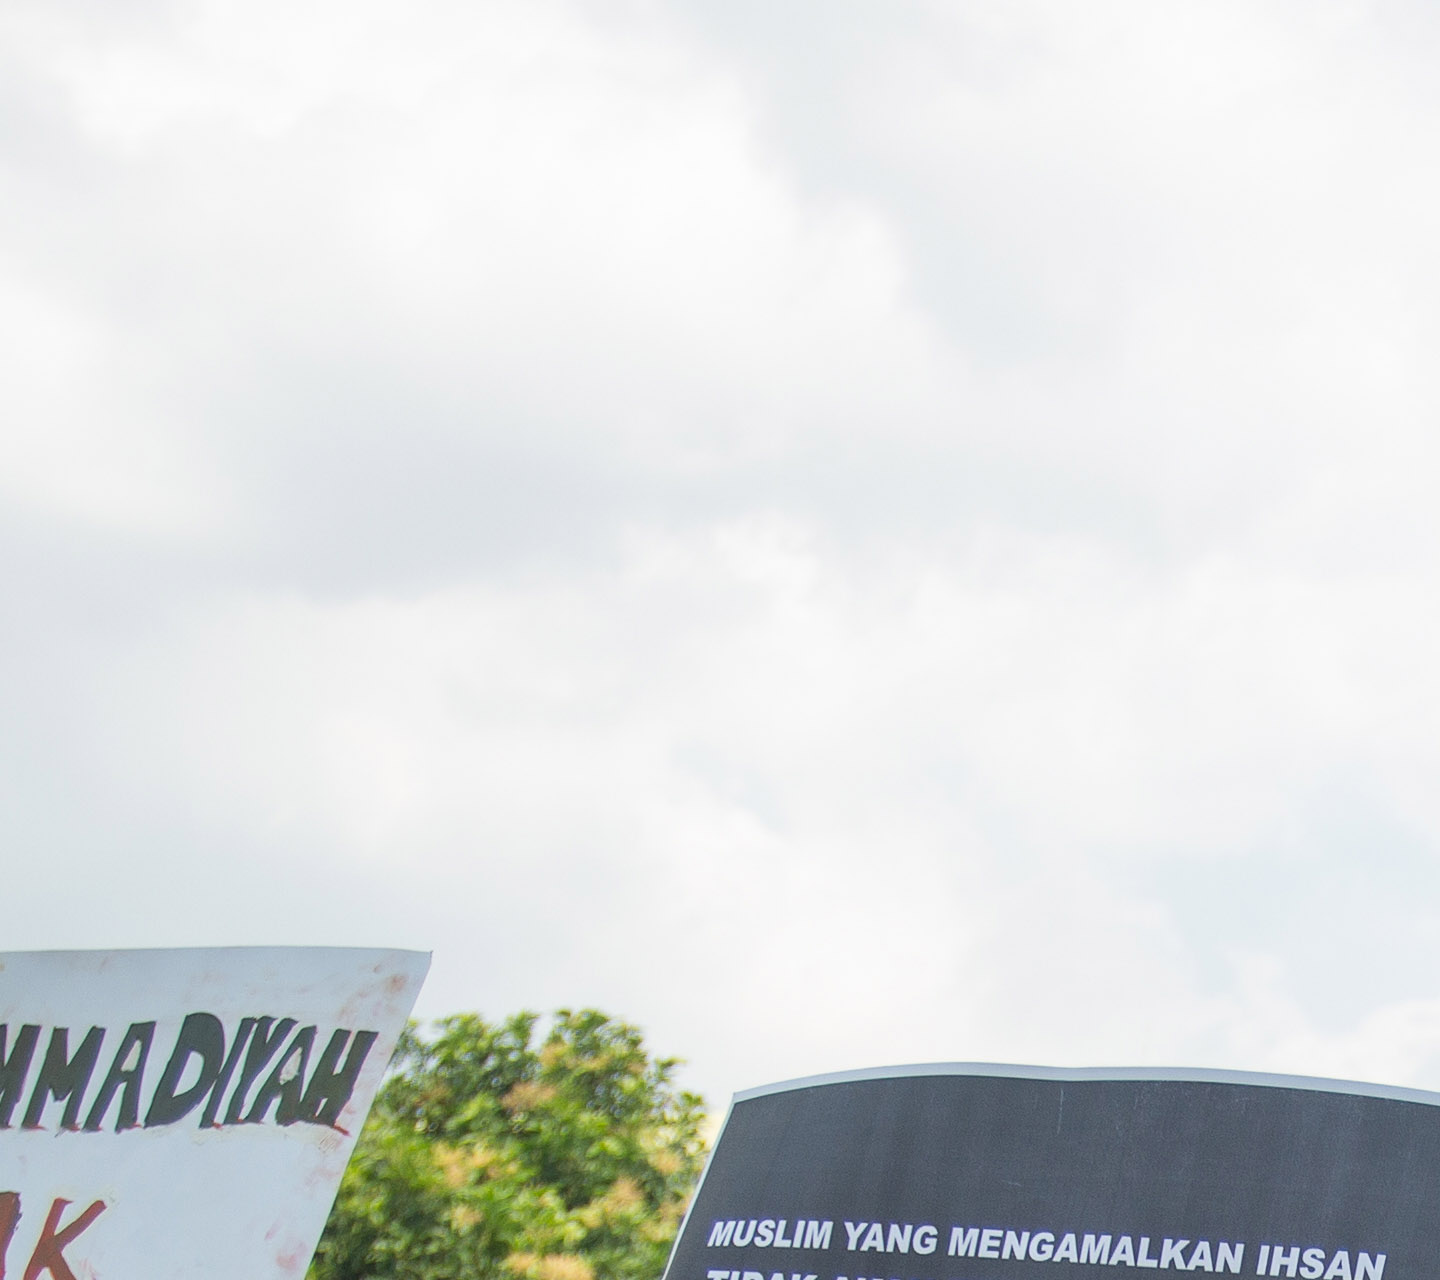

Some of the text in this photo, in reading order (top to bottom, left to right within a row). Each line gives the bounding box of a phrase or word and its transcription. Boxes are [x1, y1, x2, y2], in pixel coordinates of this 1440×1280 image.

[707, 1219, 833, 1249] MUSLIM
[844, 1222, 938, 1254] YANG
[948, 1227, 1244, 1273] MENGAMALKAN
